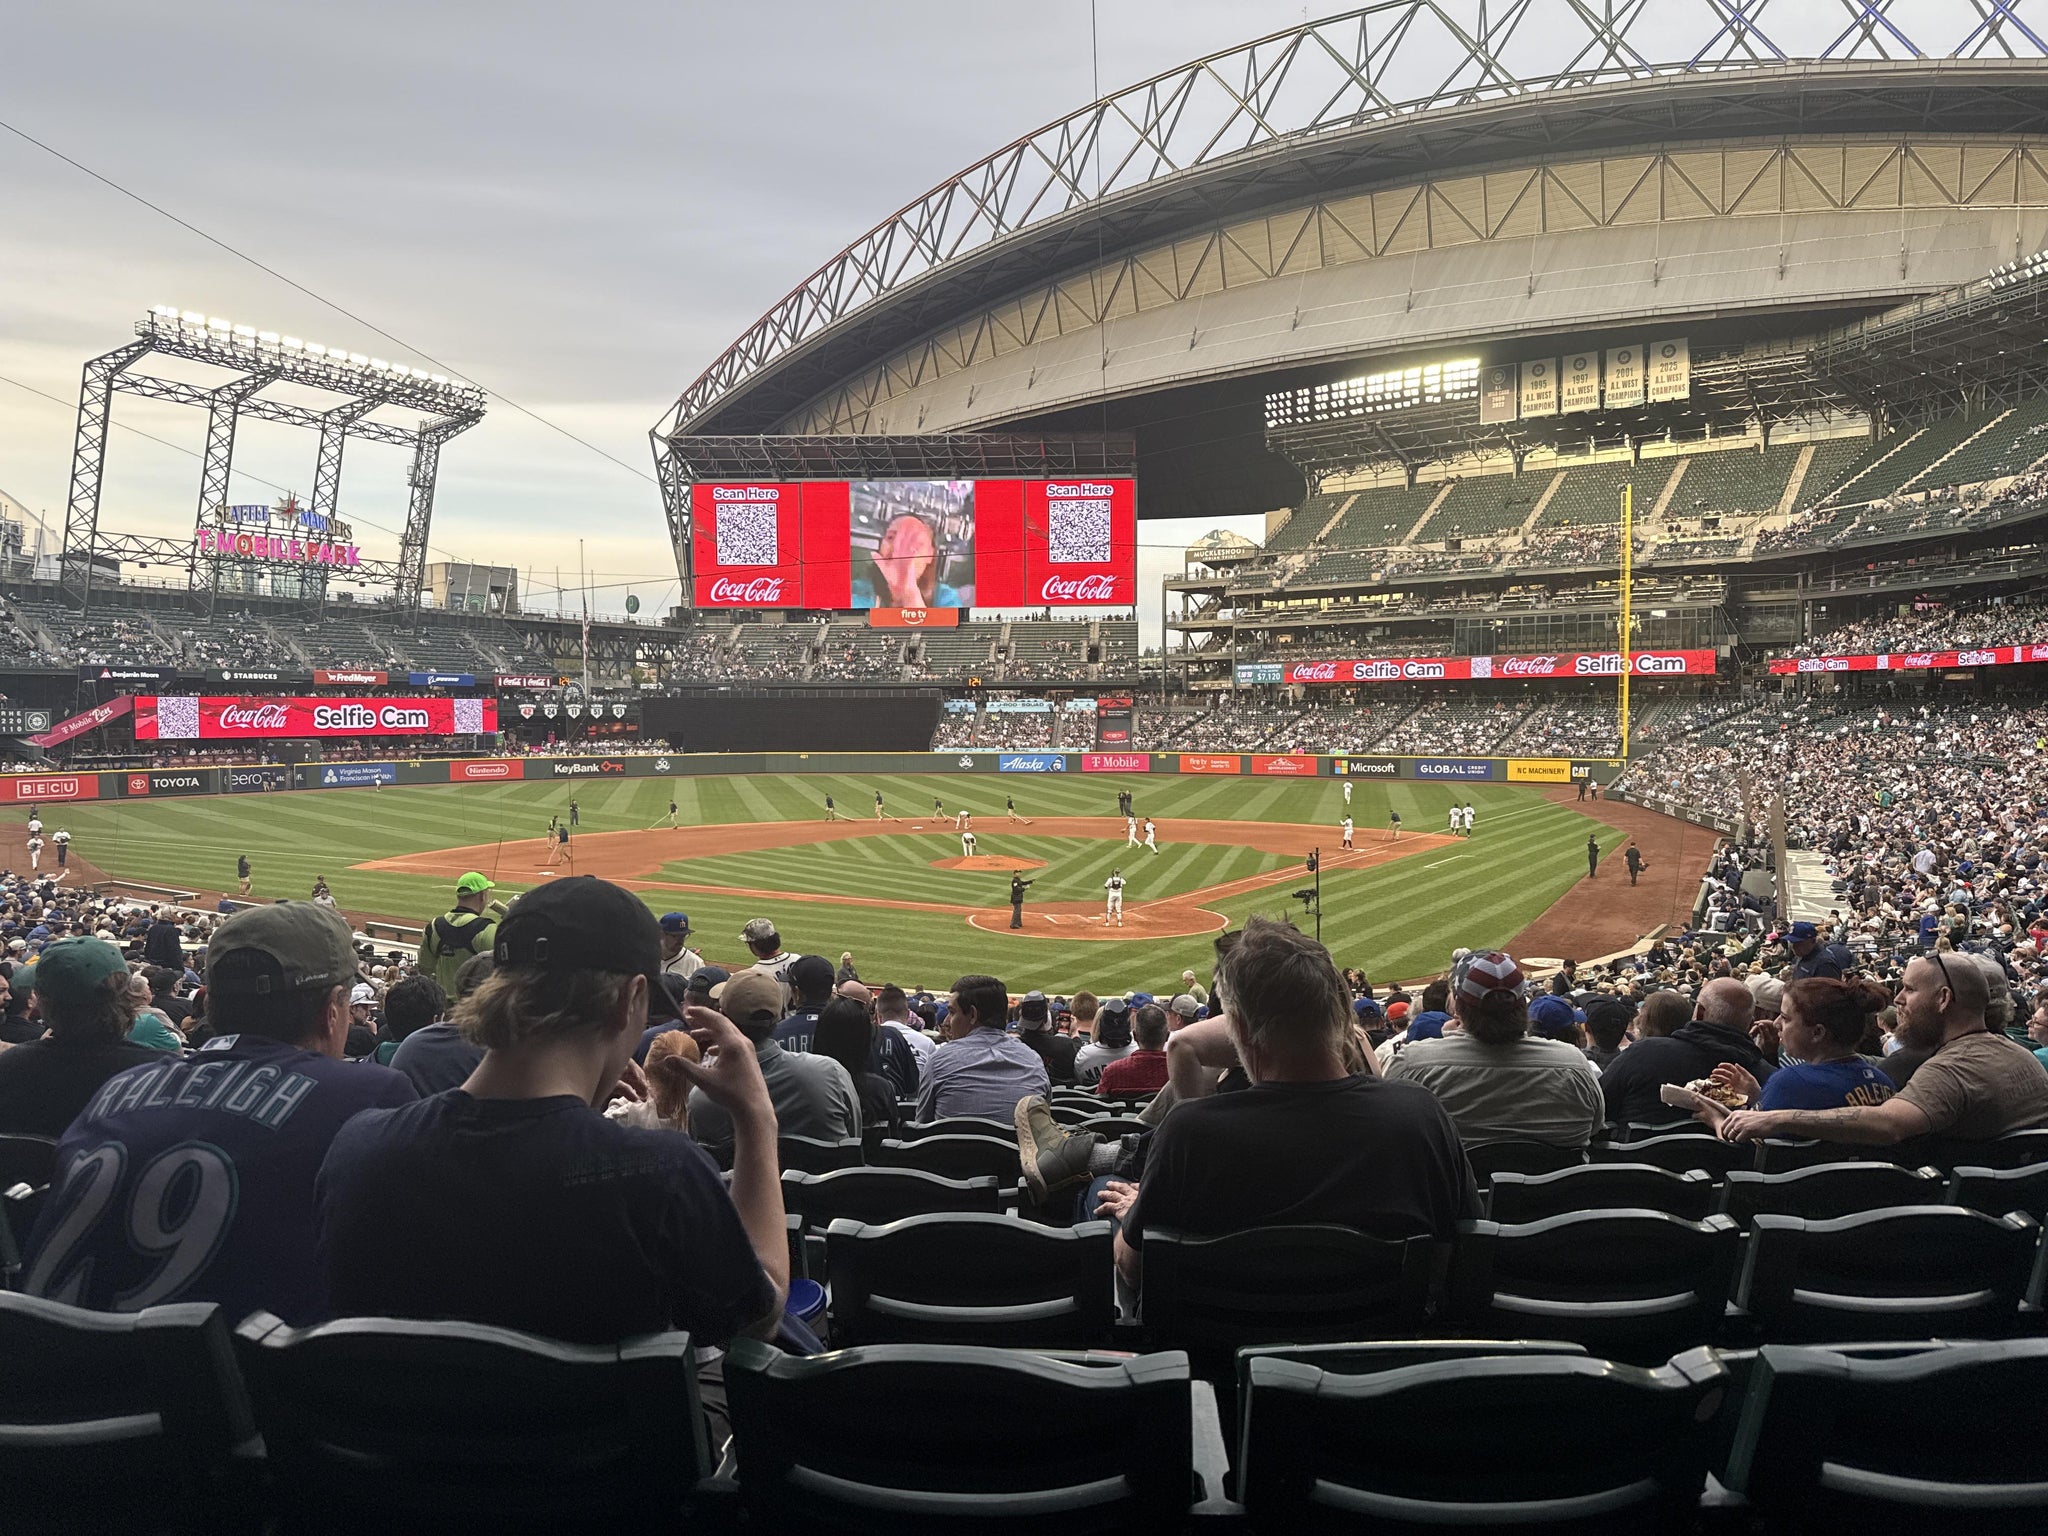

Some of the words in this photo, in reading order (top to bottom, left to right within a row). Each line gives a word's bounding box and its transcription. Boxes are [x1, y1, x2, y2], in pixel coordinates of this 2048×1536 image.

[1616, 367, 1633, 379] 2001
[1660, 362, 1678, 373] 2025
[1572, 374, 1589, 384] 1997
[1667, 373, 1682, 382] WEST
[1531, 380, 1547, 391] 1995
[1622, 379, 1638, 389] WEST
[1577, 385, 1594, 395] WEST
[1652, 384, 1686, 396] CHAMPIONS
[1536, 391, 1552, 401] WEST
[1563, 396, 1597, 407] CHAMPIONS
[1607, 390, 1642, 402] CHAMPIONS
[1522, 401, 1555, 412] CHAMPIONS
[714, 488, 745, 499] Scan
[748, 488, 778, 499] Here
[1047, 485, 1079, 496] Scan
[1081, 484, 1113, 495] Here
[215, 504, 270, 525] SEATTLE
[300, 510, 353, 540] MARINERS
[195, 529, 302, 561] T-MOBILE
[304, 541, 361, 567] PARK
[1193, 548, 1245, 558] MUCKLESHOOT
[901, 609, 917, 618] fire
[917, 610, 927, 618] tv
[1637, 655, 1685, 672] Cam
[1958, 652, 1980, 665] Selfie
[1981, 651, 1996, 664] Cam
[1354, 662, 1400, 679] Selfie
[1403, 662, 1444, 679] Cam
[1799, 660, 1823, 671] Selfie
[1826, 659, 1848, 670] Cam
[112, 671, 140, 679] Benjamin
[140, 671, 159, 679] Moore
[233, 672, 278, 680] STARBUCKS
[315, 706, 375, 727] Selfie
[380, 706, 428, 727] Cam
[69, 717, 93, 731] Mobile
[1002, 757, 1045, 770] Alaska
[1103, 756, 1139, 768] Mobile
[339, 768, 361, 776] Virginia
[469, 766, 506, 774] Nintendo
[554, 763, 600, 775] KeyBank
[1350, 762, 1395, 774] Microsoft
[1420, 763, 1465, 774] GLOBAL
[1528, 767, 1565, 775] MACHINERY
[1572, 766, 1590, 778] CAT
[153, 777, 200, 788] TOYOTA
[231, 774, 262, 785] eero
[340, 774, 370, 782] Franciscan
[87, 1059, 319, 1132] RALEIGH
[22, 1139, 240, 1313] 29
